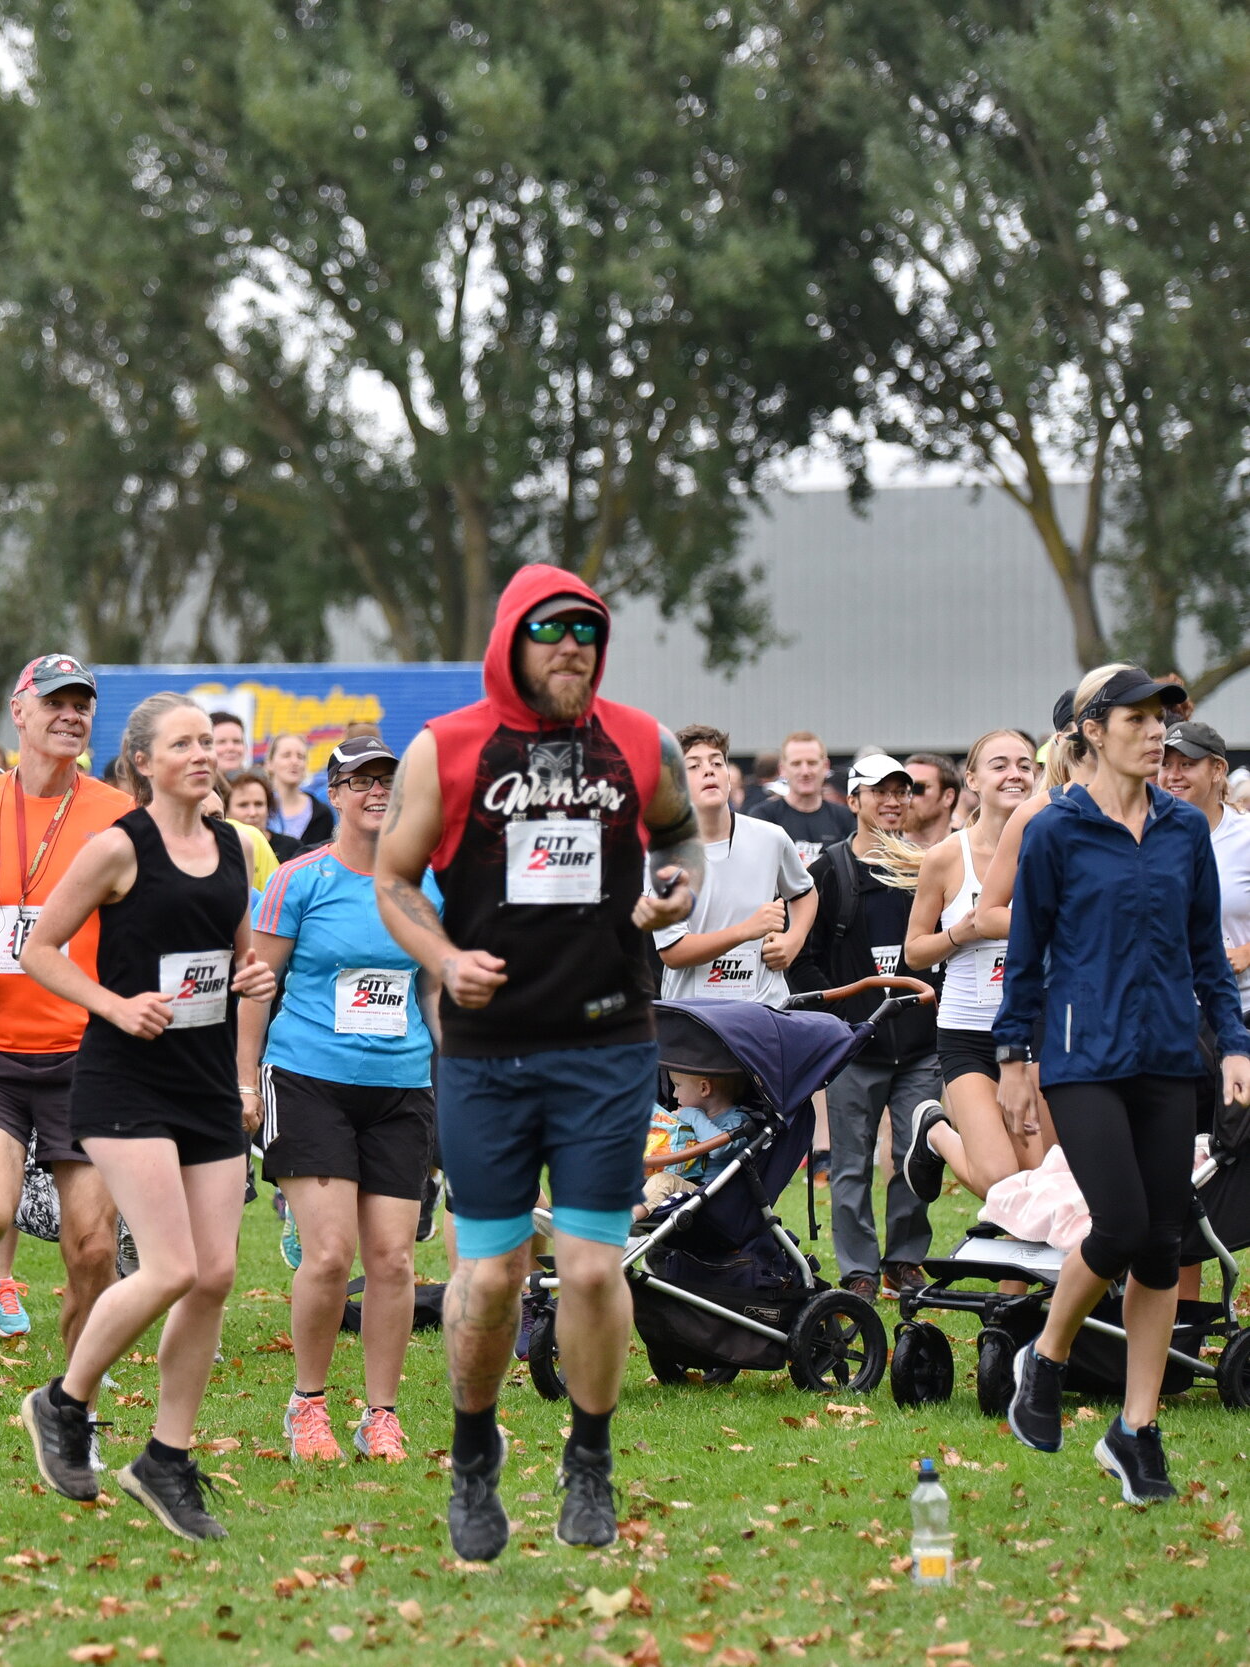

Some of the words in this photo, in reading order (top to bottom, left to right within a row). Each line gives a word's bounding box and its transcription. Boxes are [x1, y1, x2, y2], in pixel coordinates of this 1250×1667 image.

[484, 772, 626, 815] Warriors
[534, 836, 578, 850] CITY
[712, 960, 742, 970] CITY
[184, 965, 217, 981] CITY
[357, 979, 393, 993] CITY
